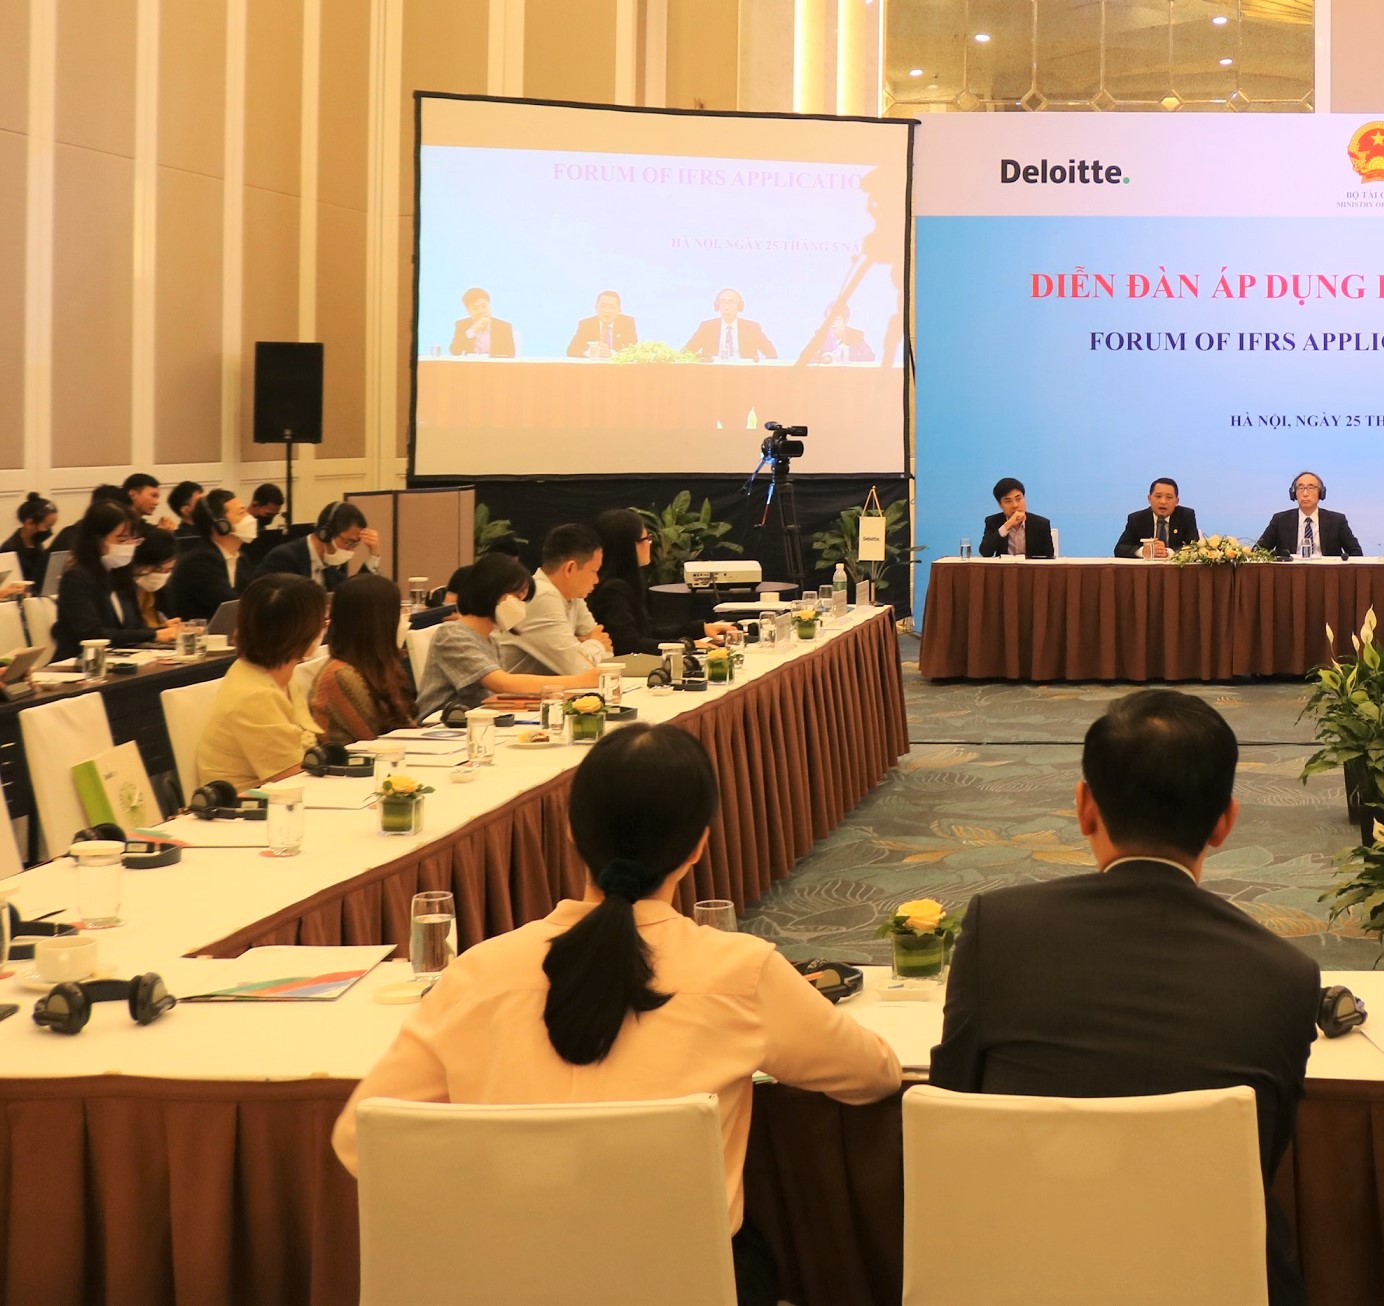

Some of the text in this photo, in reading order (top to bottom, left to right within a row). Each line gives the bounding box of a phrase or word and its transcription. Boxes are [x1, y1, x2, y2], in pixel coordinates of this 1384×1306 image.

[552, 163, 864, 190] FORUM OF IFRS APPLICATIO
[1000, 159, 1131, 184] Deloitte.
[766, 239, 779, 250] 25
[831, 241, 839, 252] 5
[1028, 265, 1117, 299] DIỄN
[1126, 265, 1200, 299] ĐÀN
[1211, 266, 1257, 299] ÁP
[1264, 273, 1367, 307] DỤNG
[1089, 331, 1186, 351] FORUM
[1194, 331, 1231, 351] OF
[1238, 331, 1296, 351] IFRS
[1230, 411, 1253, 427] HÀ
[1296, 412, 1342, 427] NGÀY
[1346, 415, 1361, 427] 25
